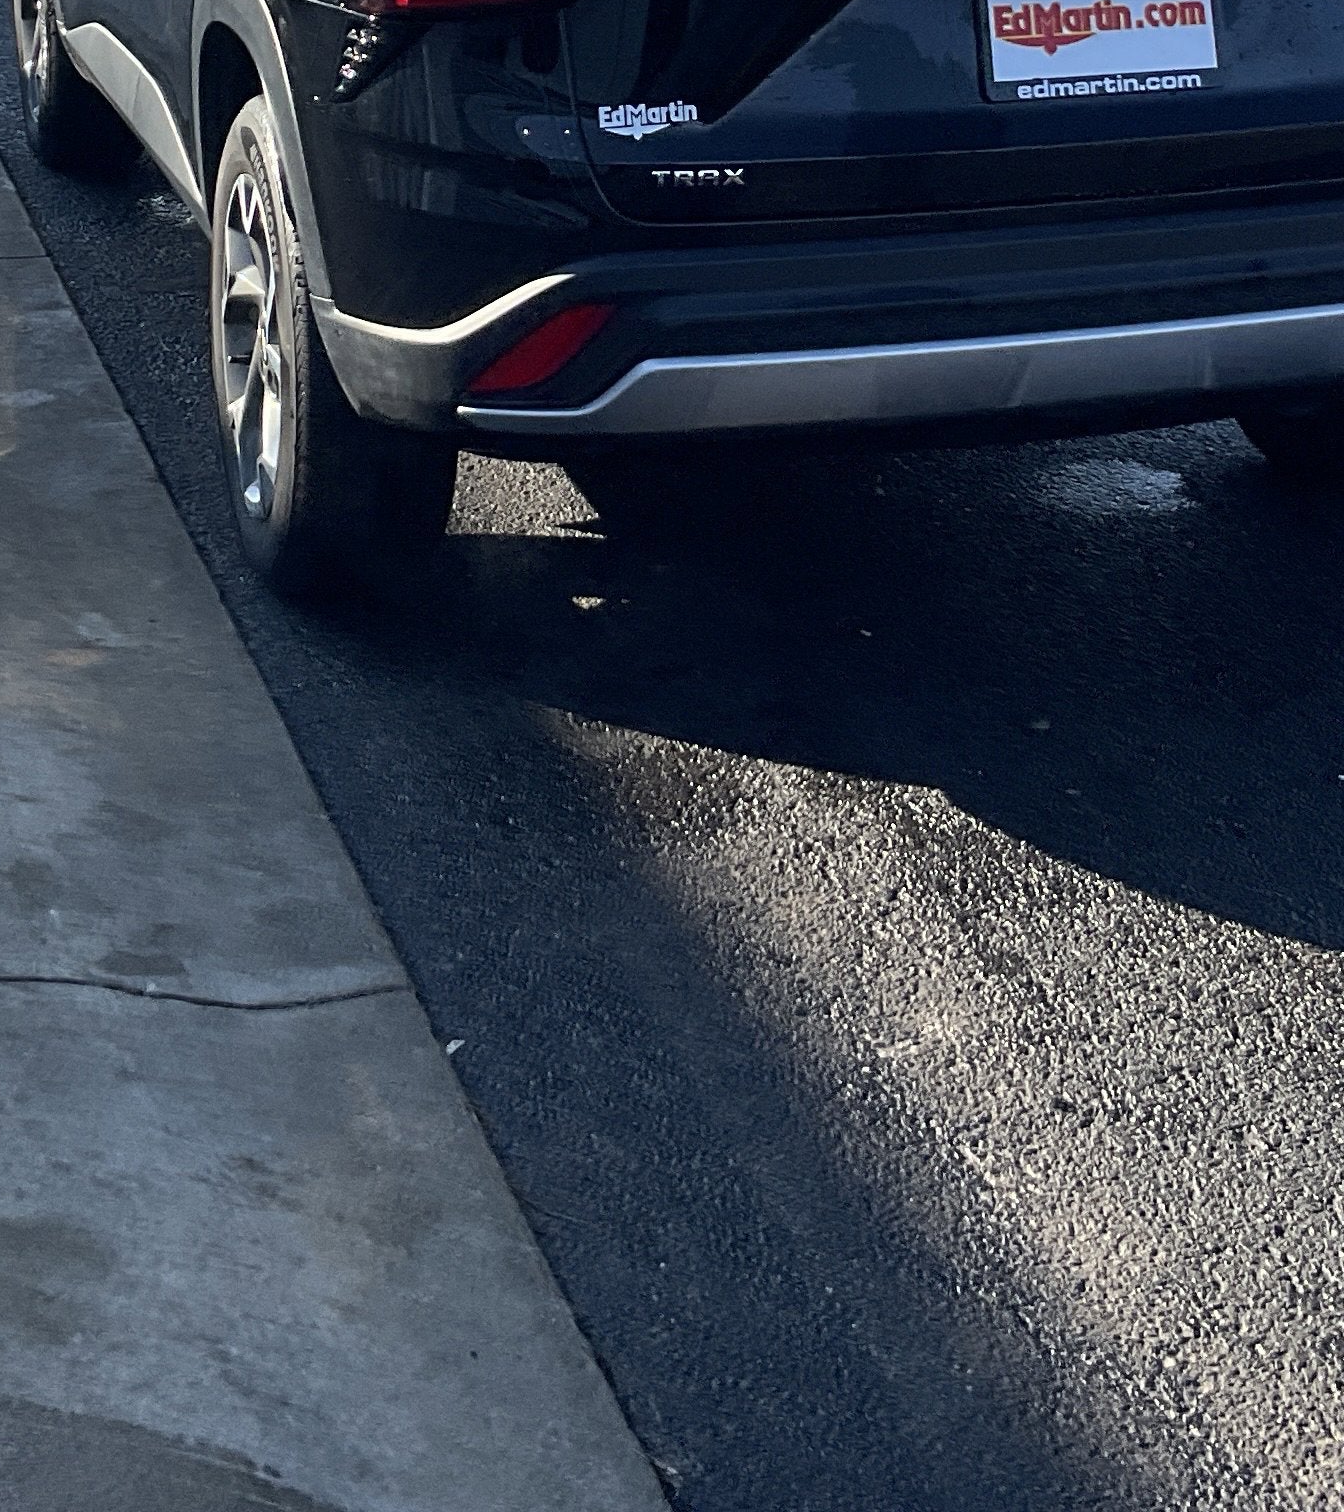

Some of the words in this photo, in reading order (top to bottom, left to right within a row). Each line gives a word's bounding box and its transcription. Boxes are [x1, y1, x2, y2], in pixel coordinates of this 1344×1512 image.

[1016, 73, 1202, 100] edmartin.com
[598, 100, 698, 129] EdMartin
[651, 167, 745, 187] TRAX
